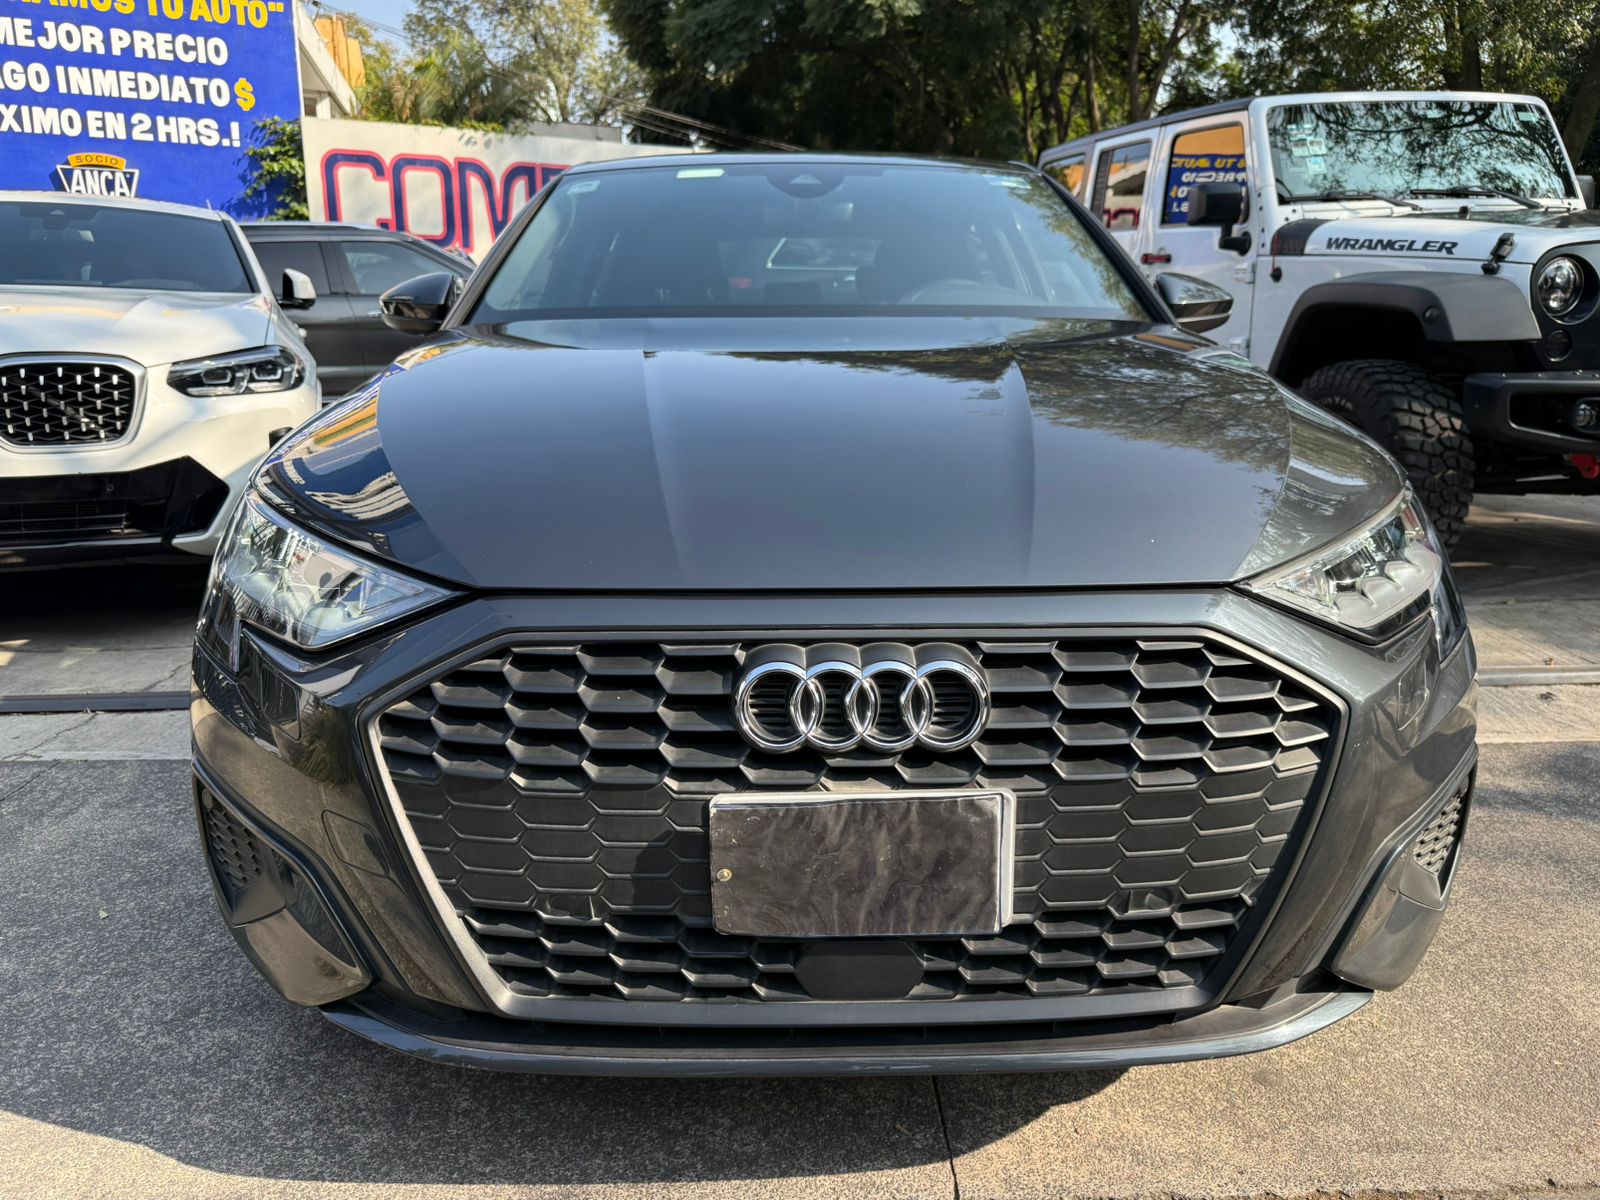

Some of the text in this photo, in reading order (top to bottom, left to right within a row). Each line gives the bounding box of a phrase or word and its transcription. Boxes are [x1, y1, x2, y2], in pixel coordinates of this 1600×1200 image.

[110, 28, 228, 66] PRECIO
[0, 61, 256, 111] GO INMEDIATO $
[86, 110, 127, 140] EN
[130, 112, 154, 141] 2
[75, 155, 119, 165] SOCIO
[70, 169, 131, 197] ANCA
[321, 149, 573, 254] COM
[1326, 237, 1458, 255] WRANGLER
